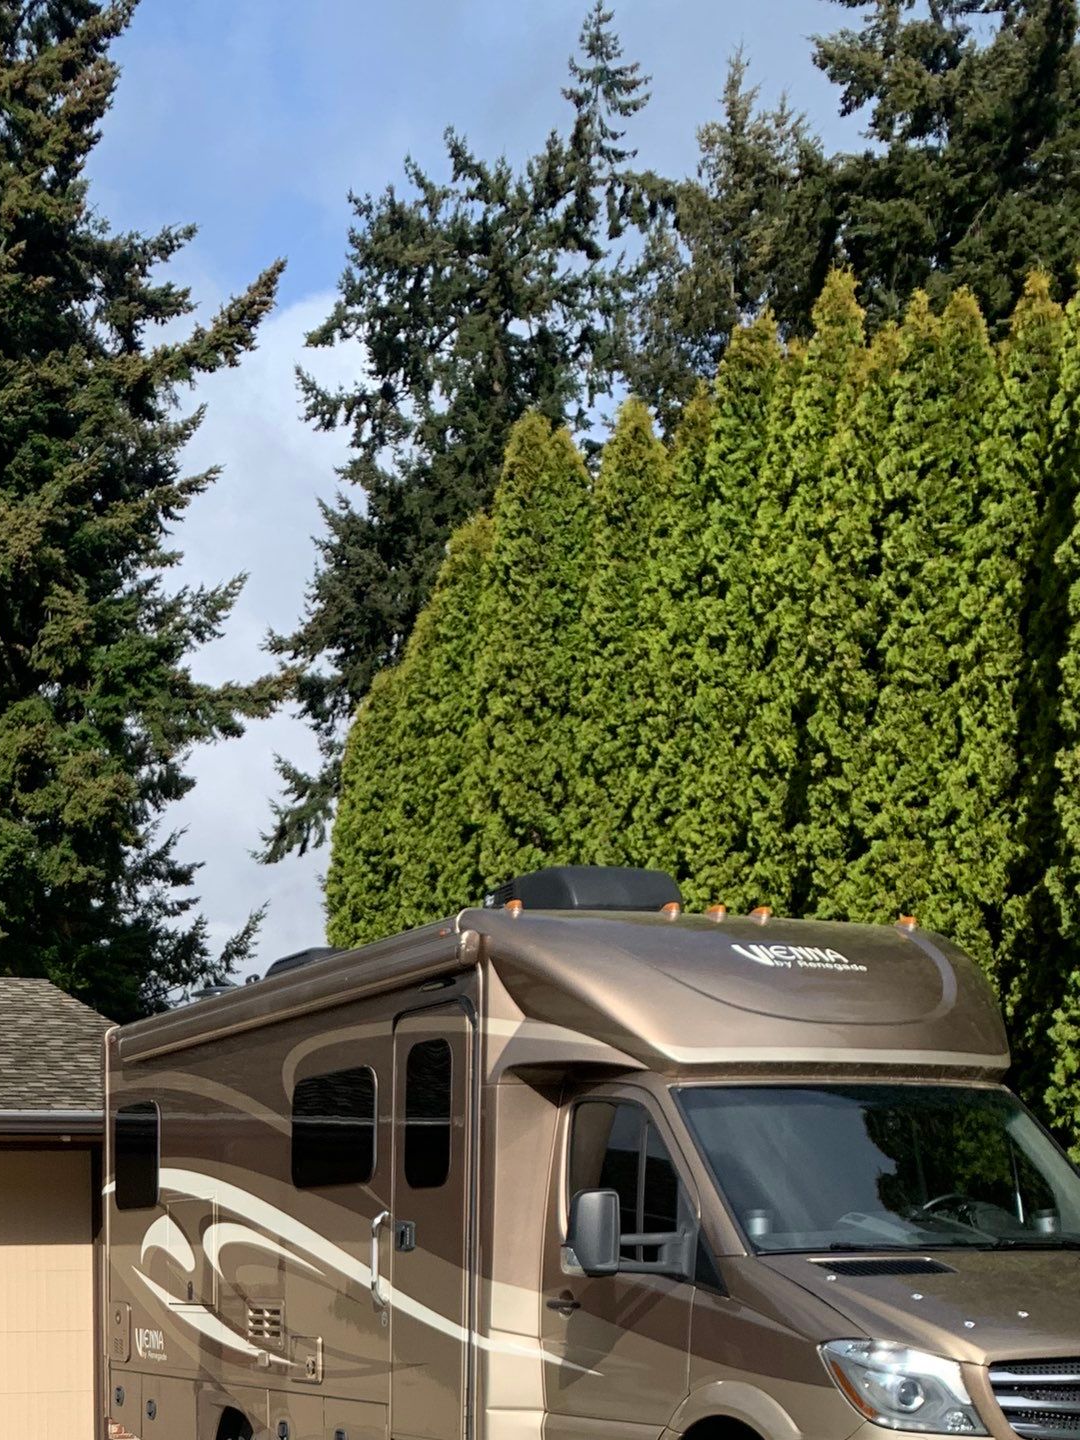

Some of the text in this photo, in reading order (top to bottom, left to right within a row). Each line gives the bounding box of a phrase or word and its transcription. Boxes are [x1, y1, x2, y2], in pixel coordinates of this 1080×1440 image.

[731, 944, 849, 967] VIENNA
[774, 960, 868, 973] by Renegade
[135, 1328, 164, 1358] VIENNA
